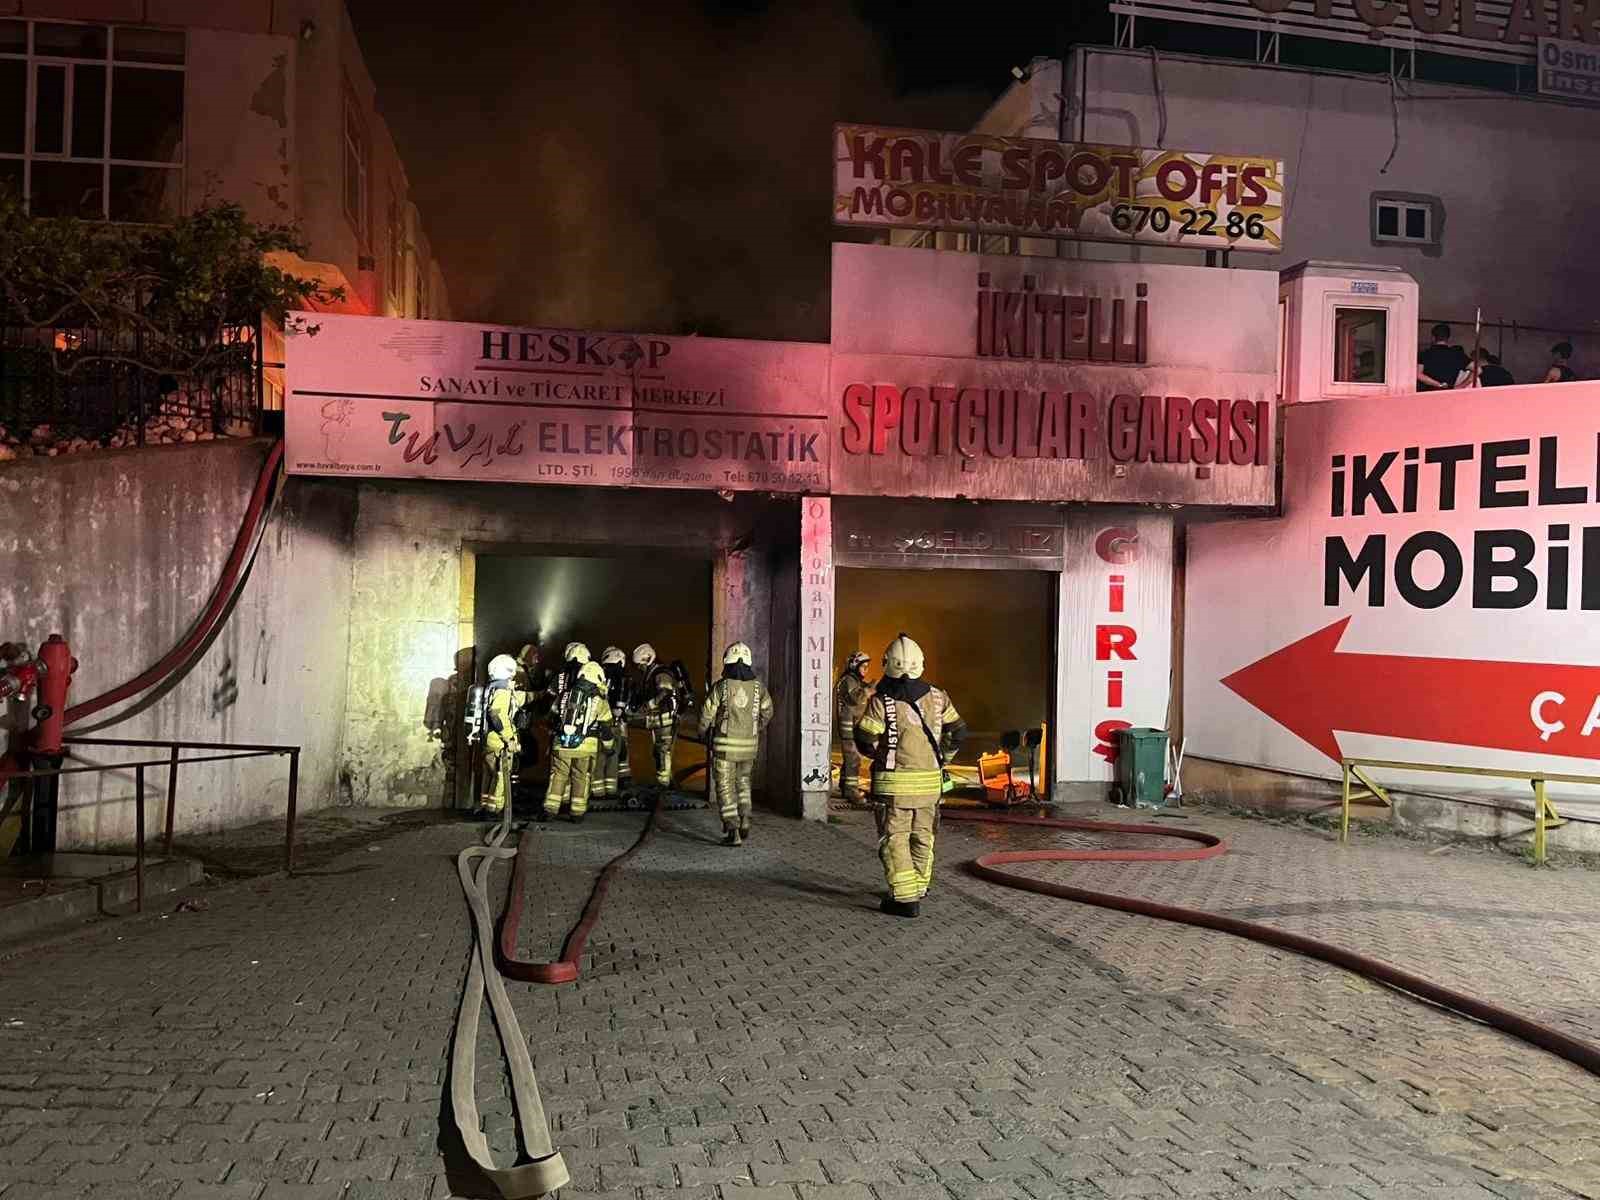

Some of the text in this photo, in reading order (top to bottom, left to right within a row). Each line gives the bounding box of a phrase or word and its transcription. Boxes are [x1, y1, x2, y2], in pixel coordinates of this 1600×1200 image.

[1543, 43, 1600, 72] Osm
[852, 135, 983, 186] KALE
[1000, 148, 1141, 197] SPOT
[1111, 204, 1171, 233] 670
[1178, 208, 1217, 236] 22
[1225, 210, 1265, 240] 86
[976, 271, 1148, 363] İKİTELLİ
[419, 374, 725, 408] SANAYİ ve TİCARET MERKEZİ
[538, 421, 820, 463] ELEKTROSTATİK
[840, 383, 1270, 479] SPOTÇULAR ÇARŞISI
[537, 463, 568, 476] LTD.
[1330, 431, 1600, 517] İKİTEL
[884, 694, 898, 748] ISTANBU
